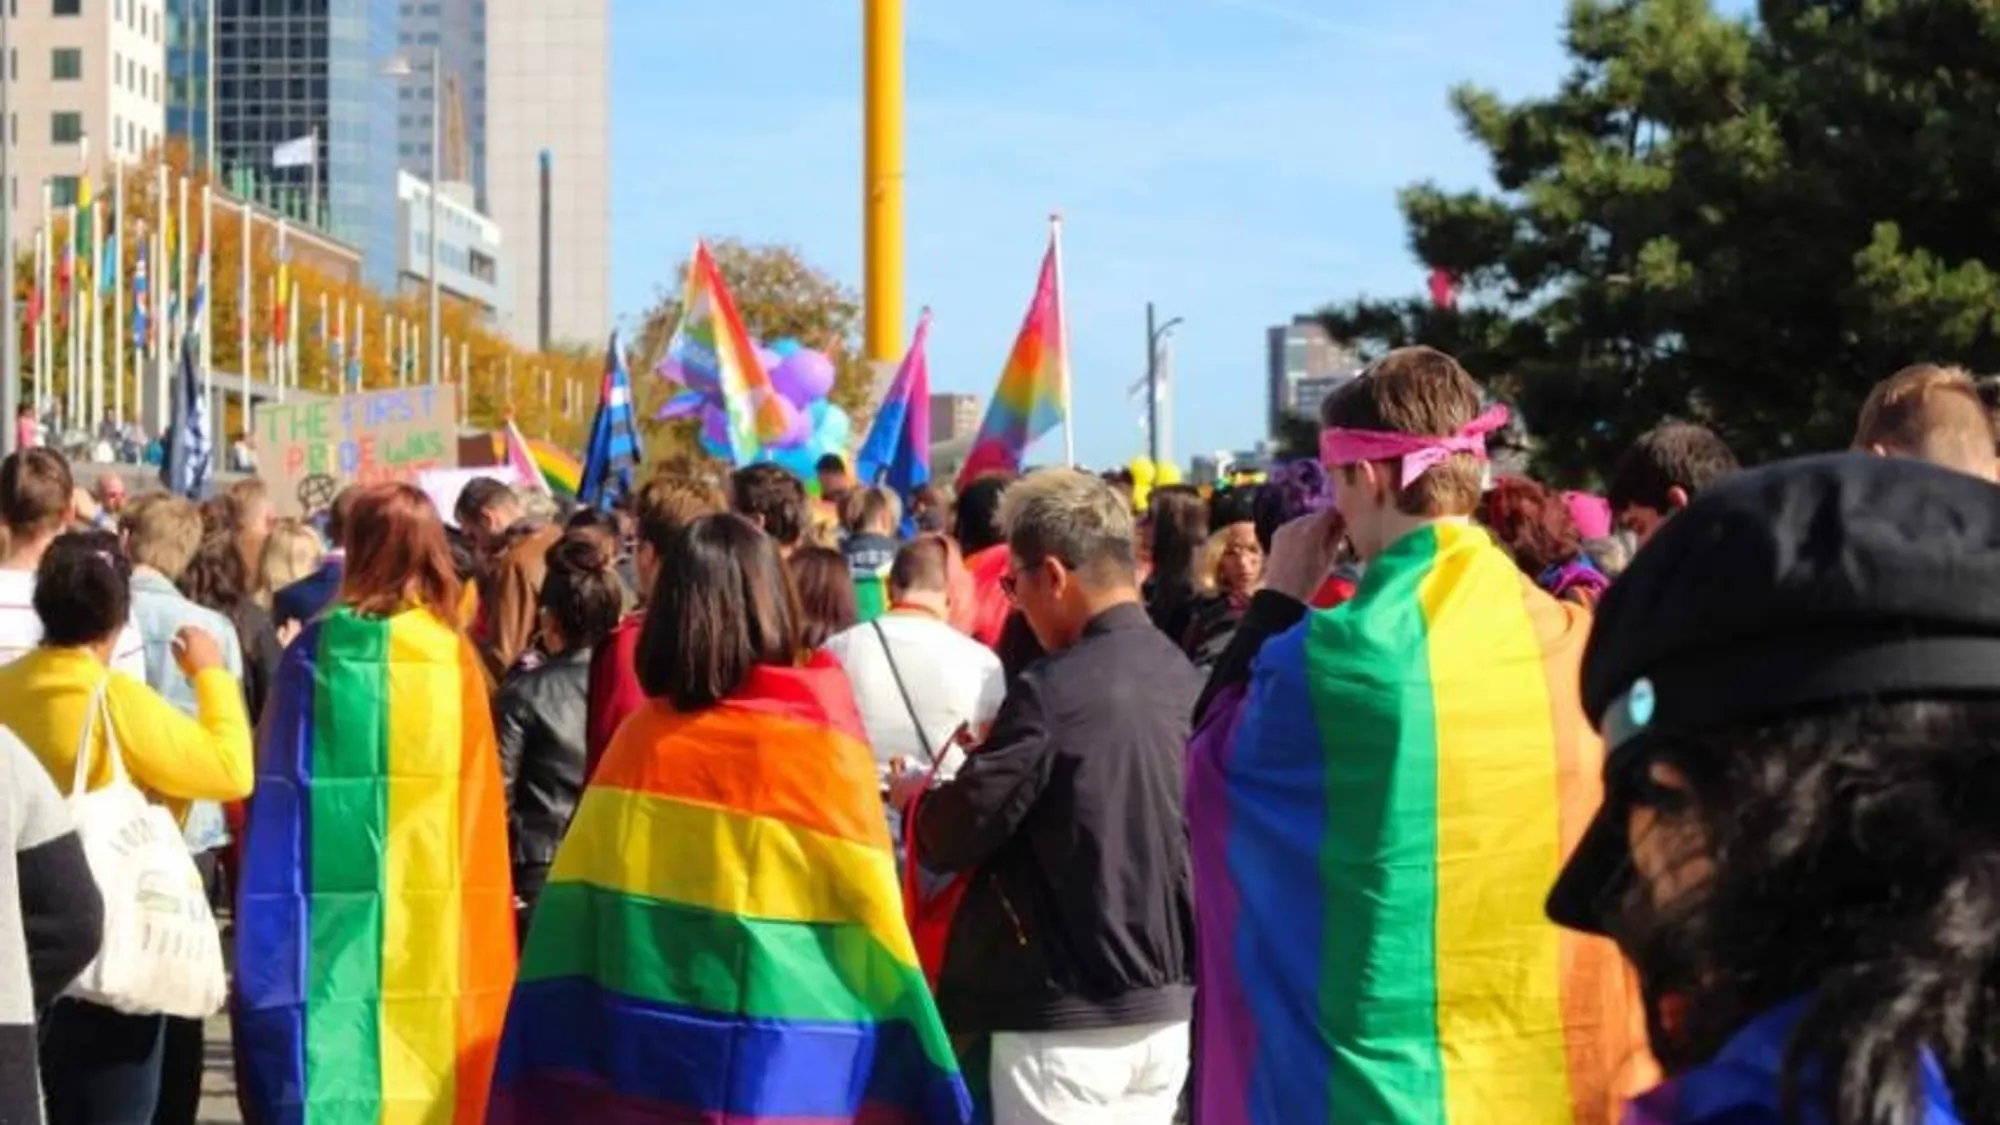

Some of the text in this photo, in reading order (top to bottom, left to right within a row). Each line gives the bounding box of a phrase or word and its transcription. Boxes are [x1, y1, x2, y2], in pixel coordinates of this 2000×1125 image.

[259, 388, 437, 445] THE FIRST
[286, 435, 376, 476] PRIDE
[385, 430, 444, 463] WAS
